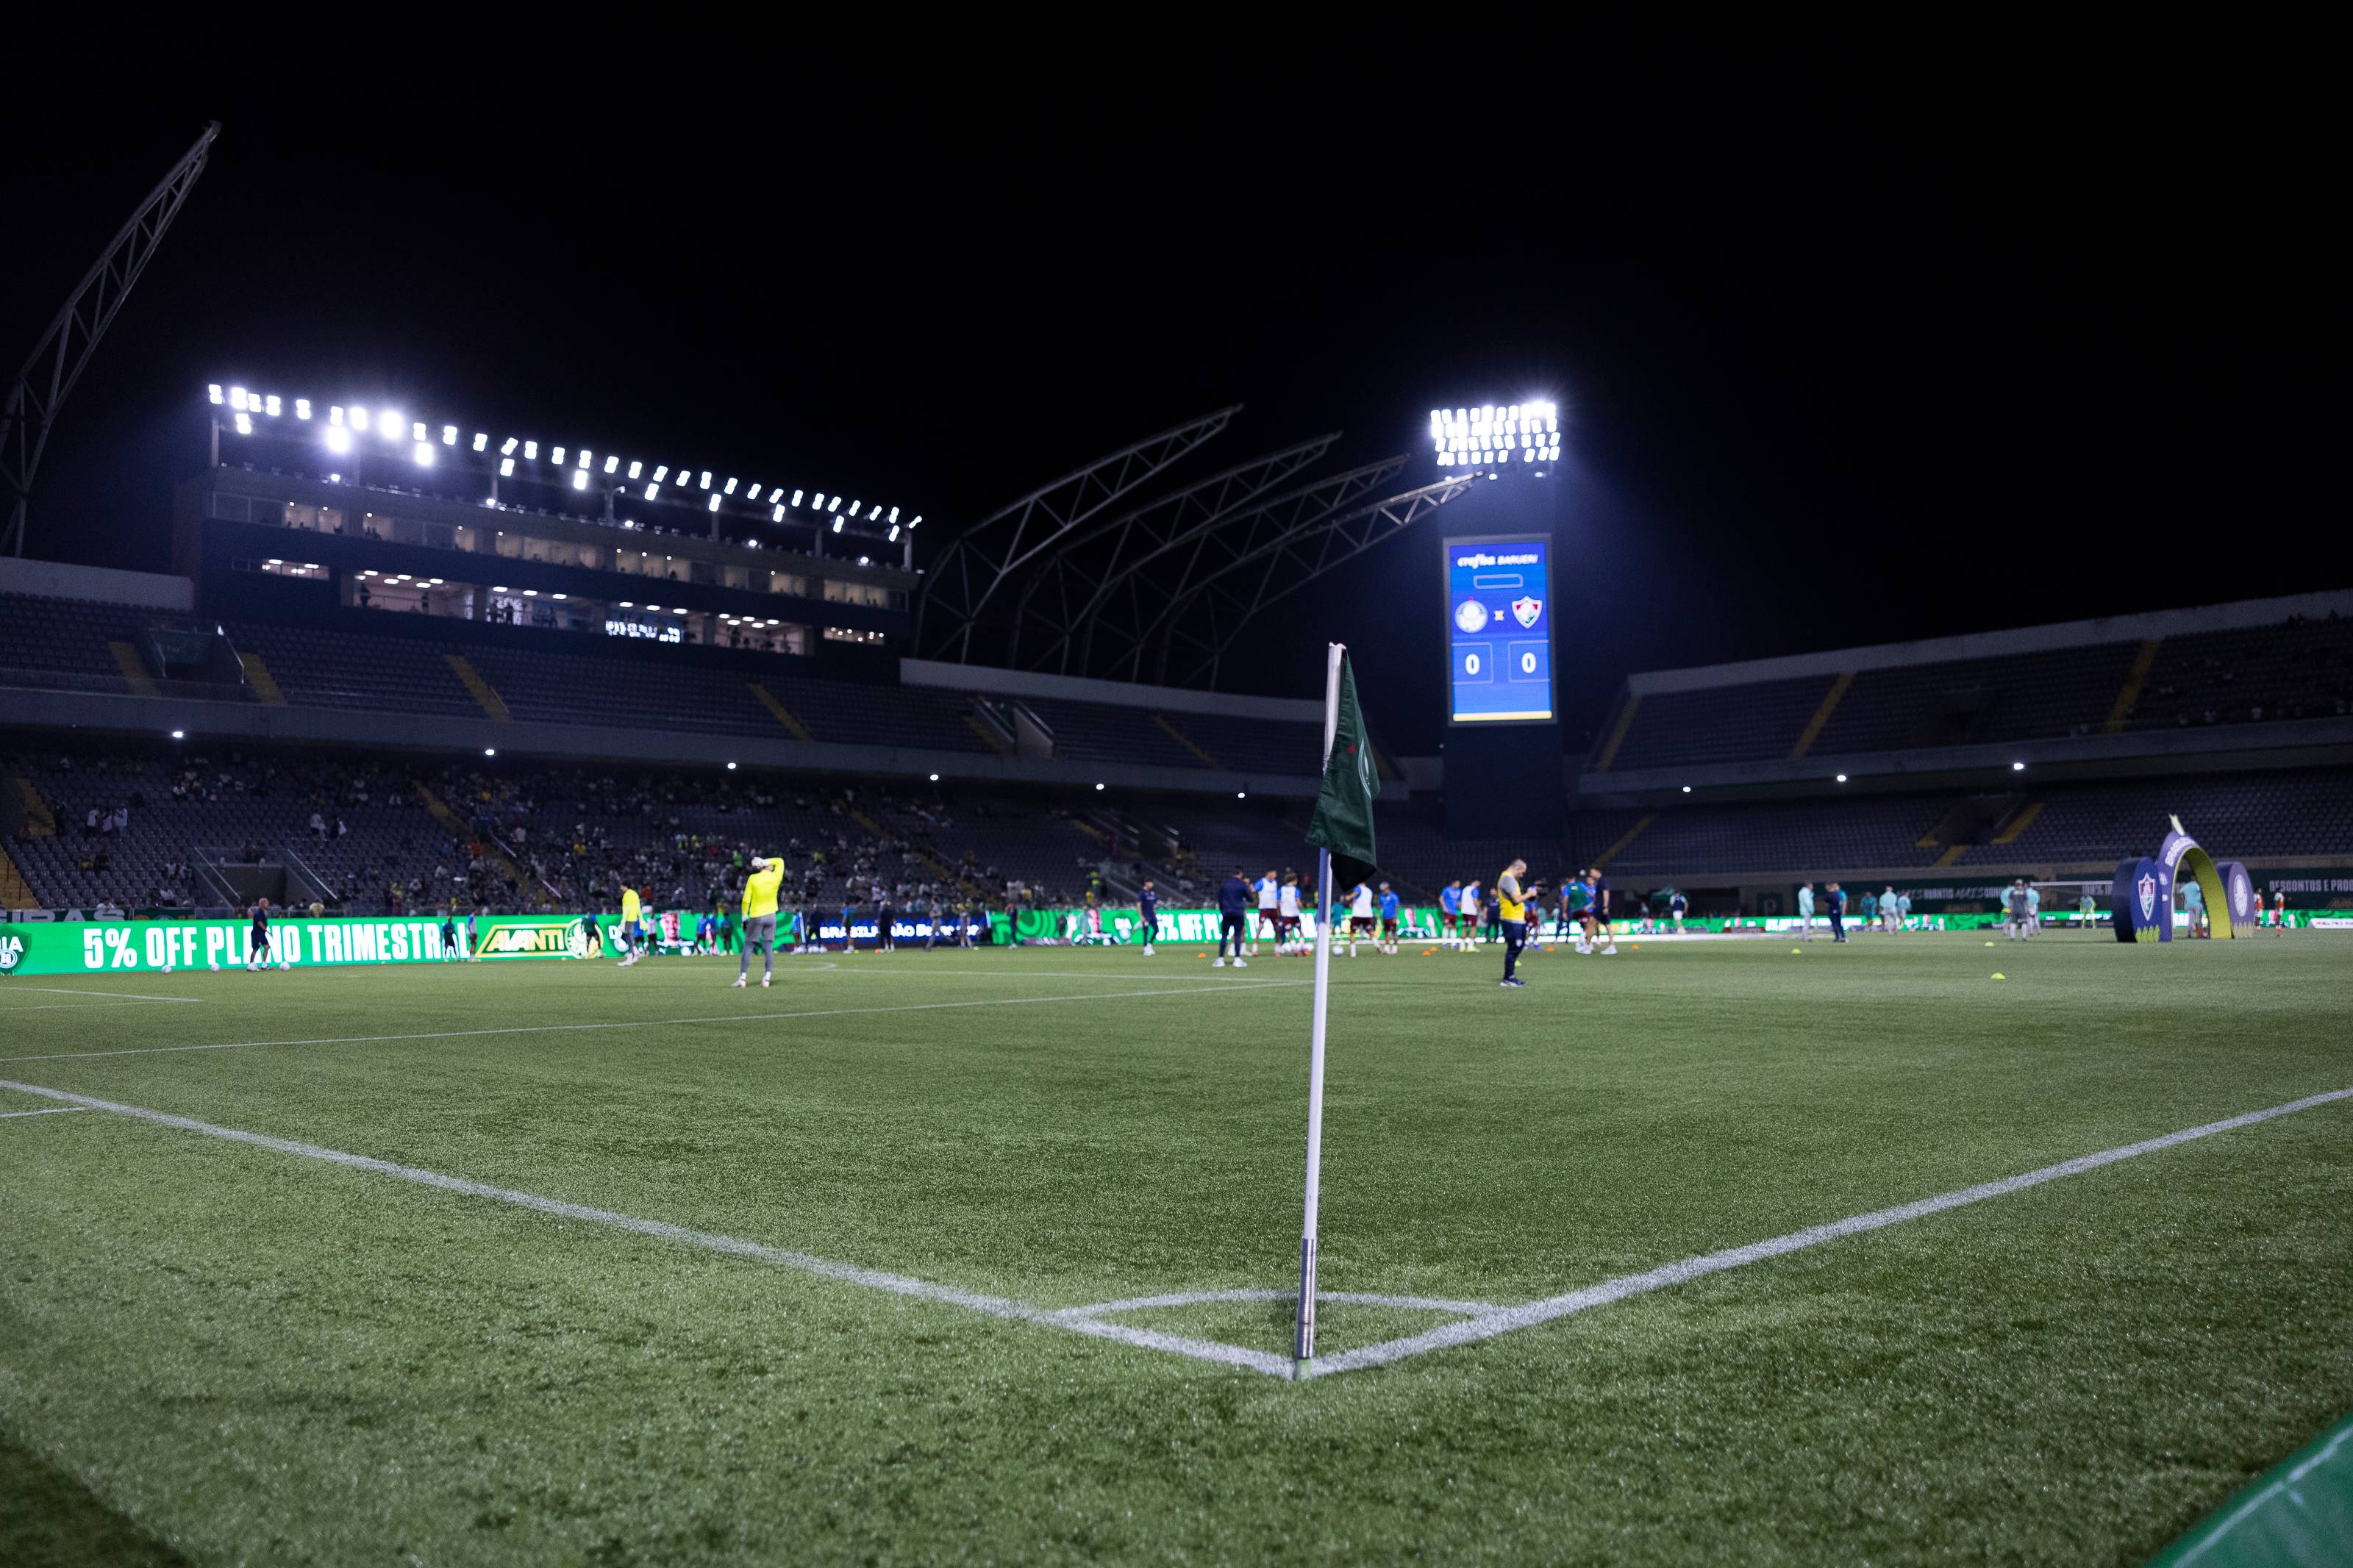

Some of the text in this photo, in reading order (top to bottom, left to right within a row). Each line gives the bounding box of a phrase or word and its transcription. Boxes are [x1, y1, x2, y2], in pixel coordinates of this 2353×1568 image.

[1465, 654, 1480, 675] 0
[1521, 652, 1536, 673] 0
[83, 928, 138, 969] 5%
[146, 927, 197, 967] OFF
[486, 929, 565, 952] AVANTI
